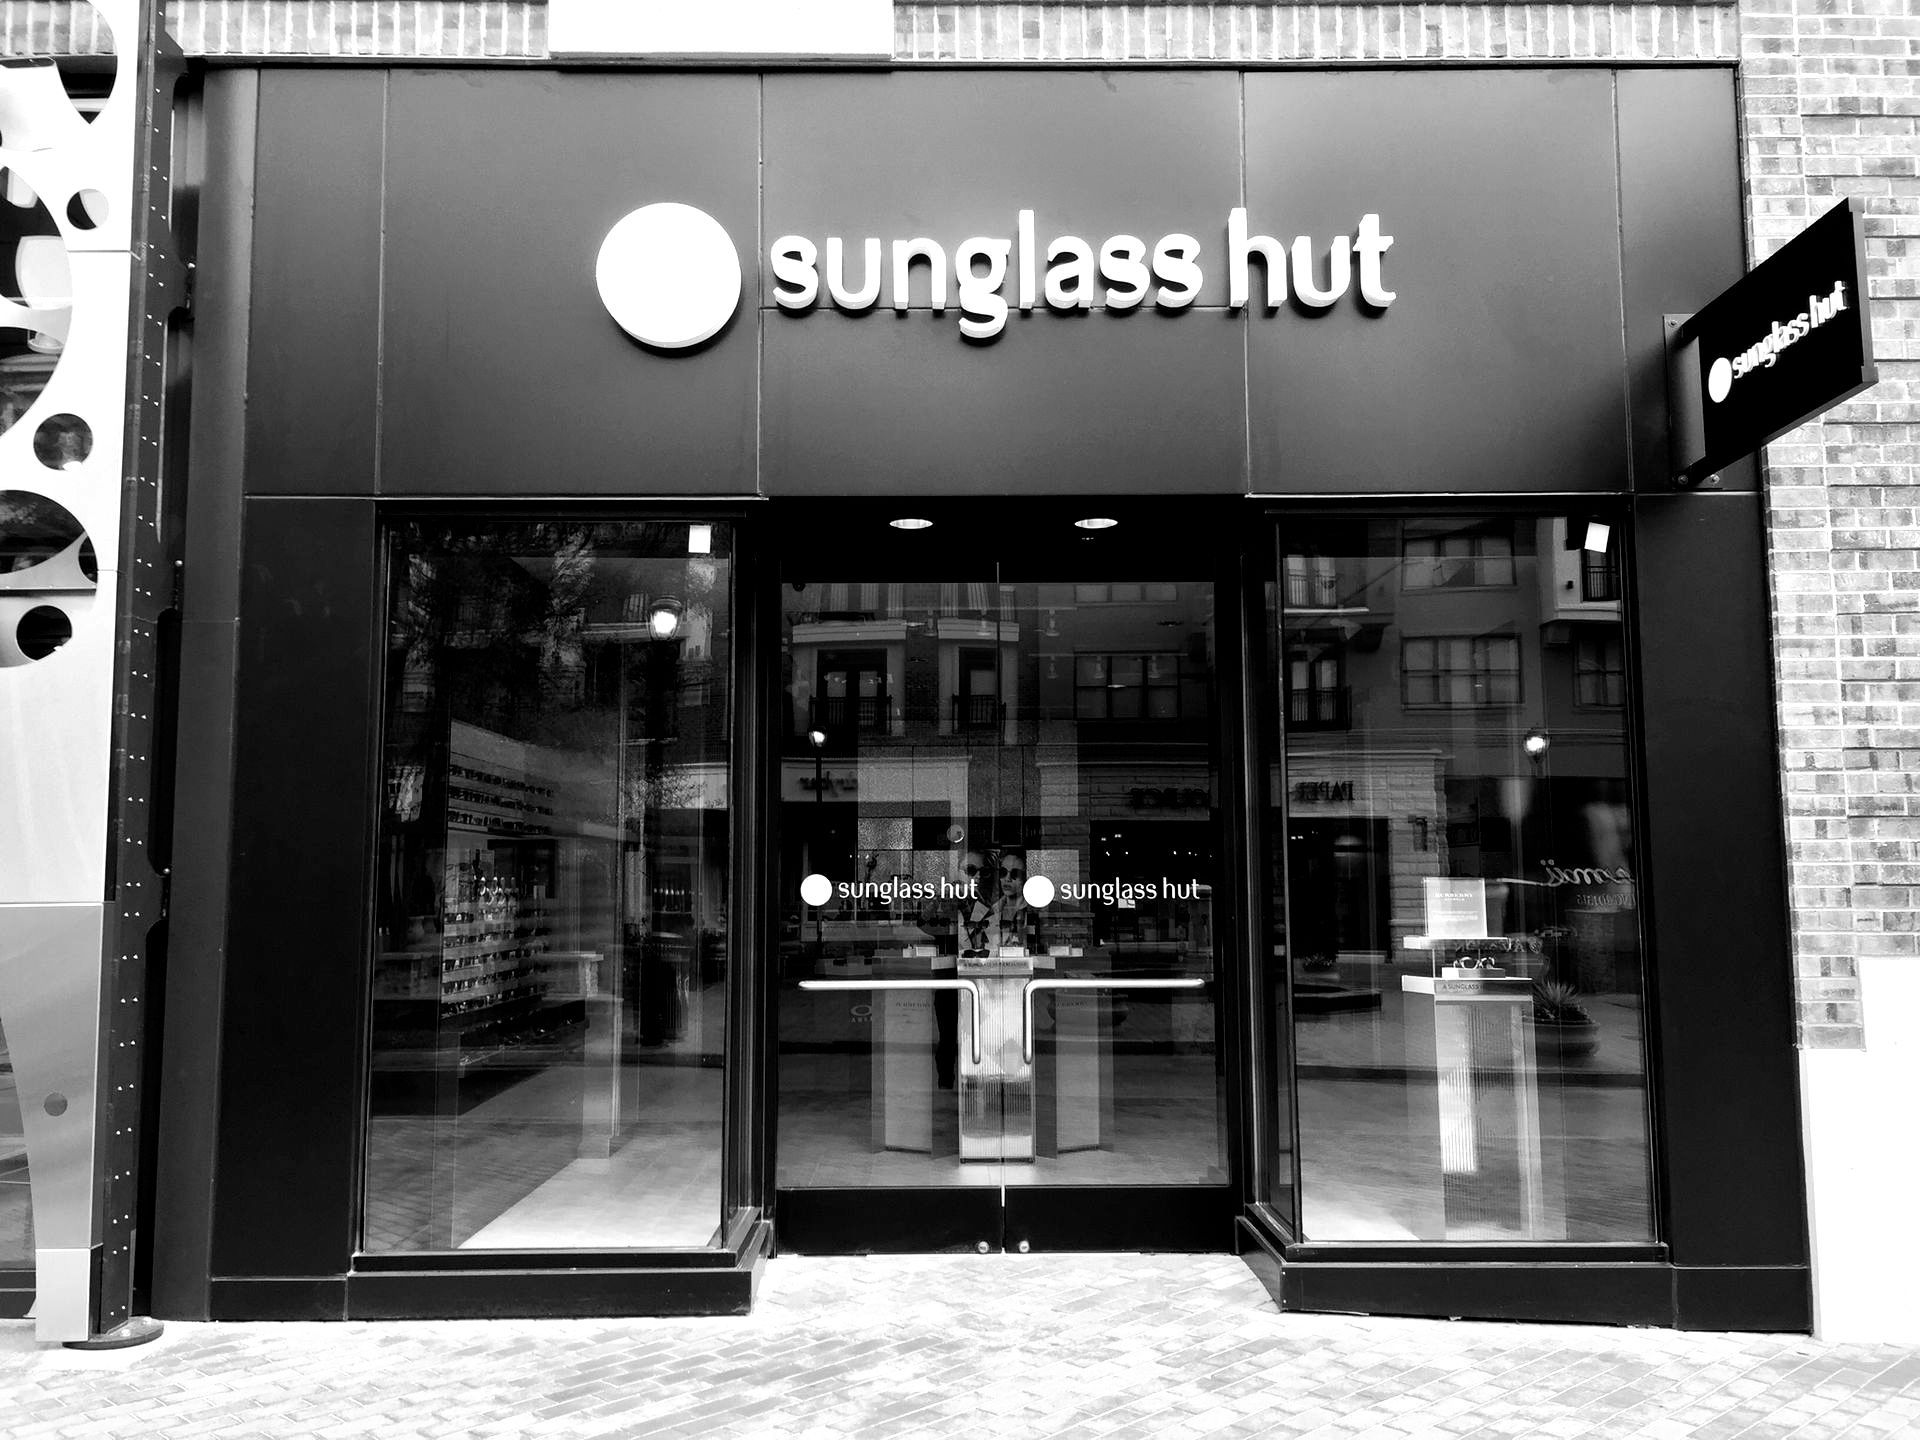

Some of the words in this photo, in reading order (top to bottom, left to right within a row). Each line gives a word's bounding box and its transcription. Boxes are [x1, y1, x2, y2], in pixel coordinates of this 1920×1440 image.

[769, 208, 1204, 340] sunglass
[1227, 206, 1397, 311] hut
[1732, 312, 1809, 379] sunglass
[1809, 281, 1847, 328] hut
[838, 876, 935, 905] sunglass
[941, 876, 978, 900] hut
[1060, 876, 1157, 906] sunglass
[1163, 876, 1200, 900] hut
